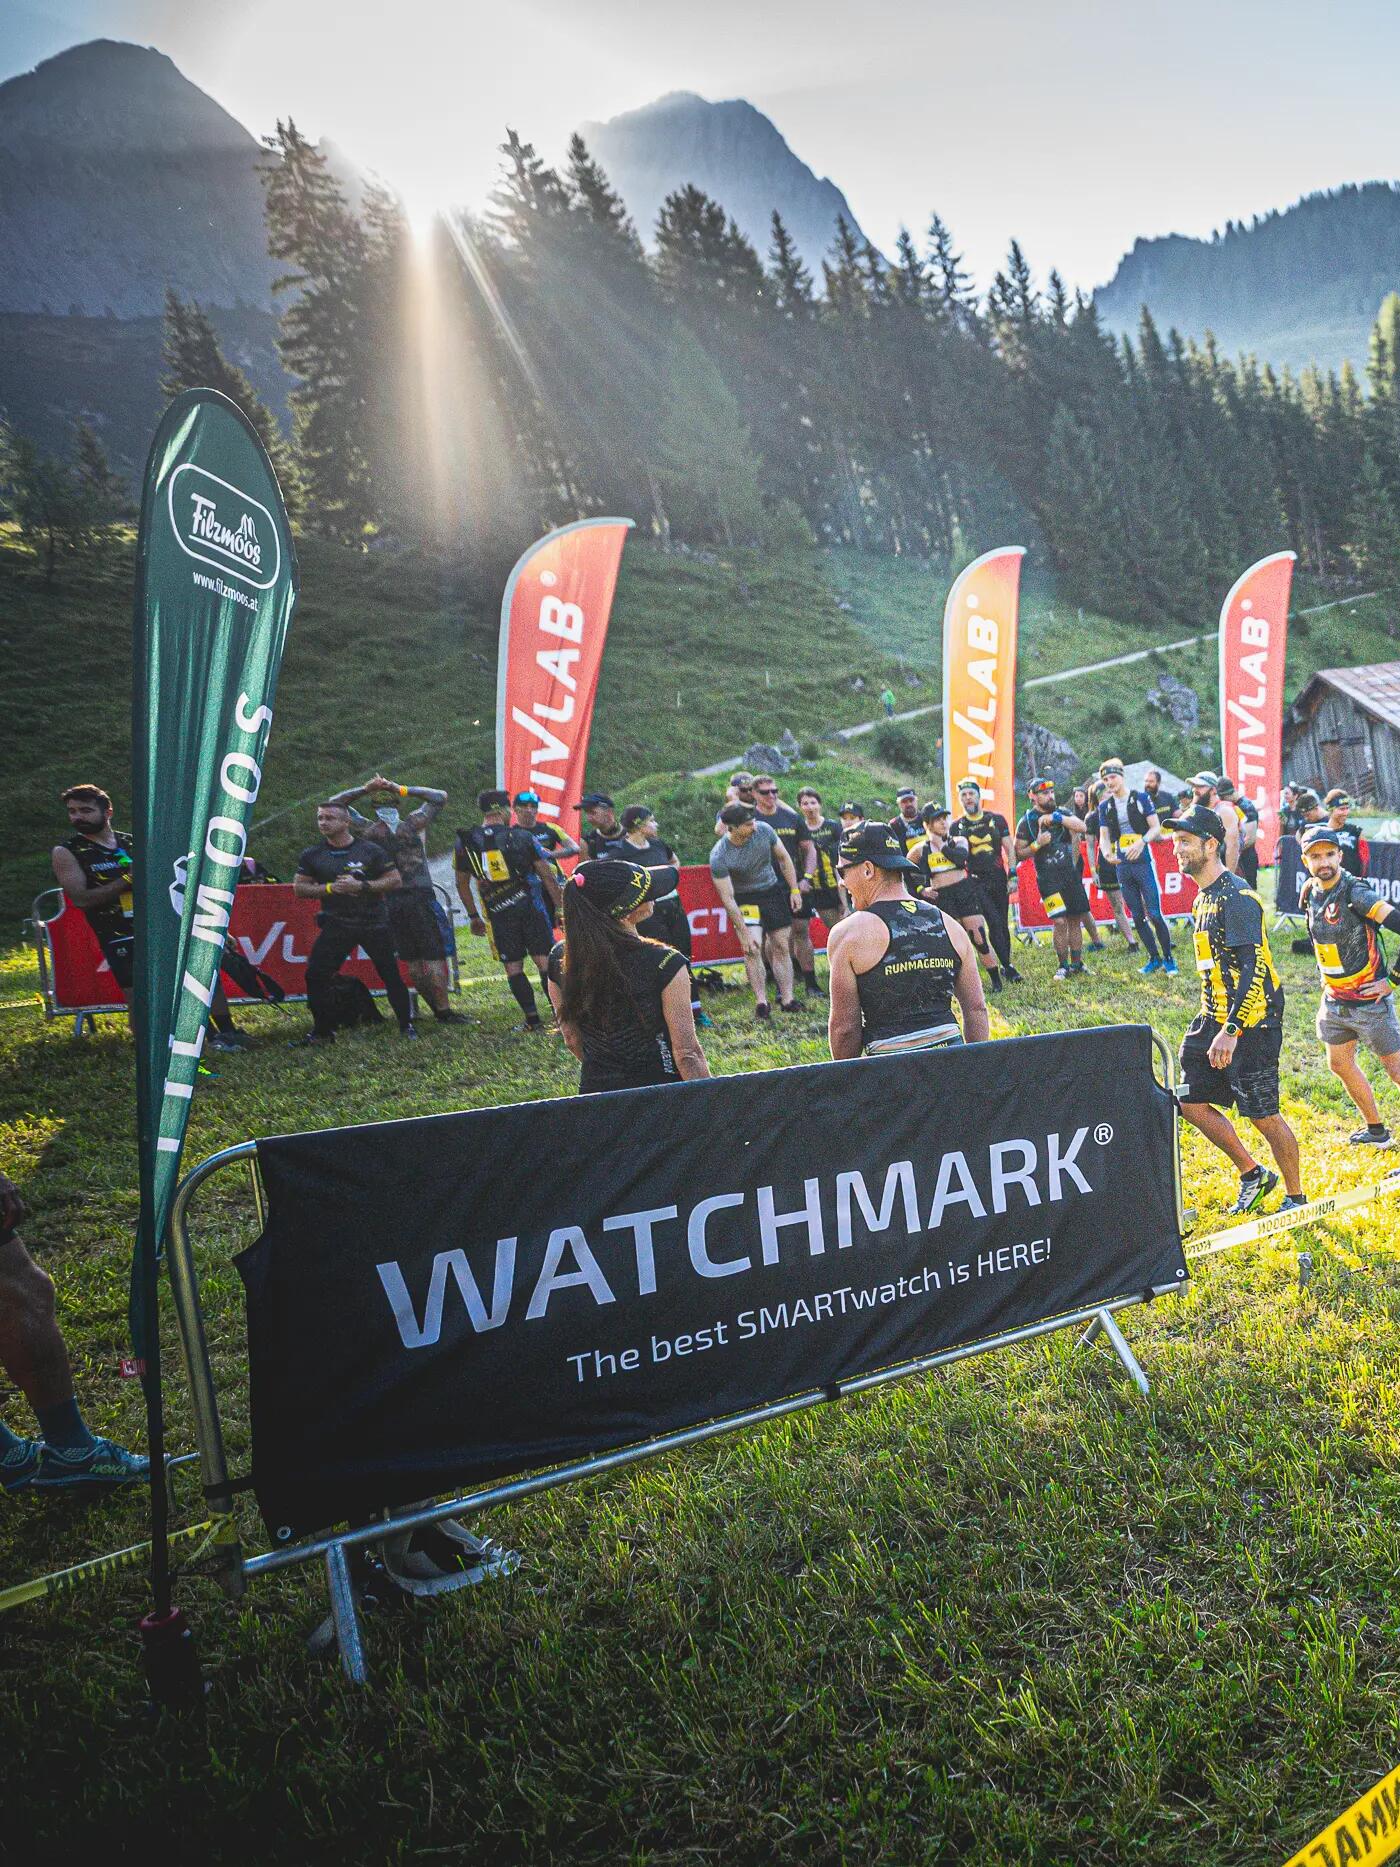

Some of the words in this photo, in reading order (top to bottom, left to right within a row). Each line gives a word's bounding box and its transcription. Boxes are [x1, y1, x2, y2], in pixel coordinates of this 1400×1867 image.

[190, 492, 261, 566] Filzmoos
[192, 571, 259, 612] www.filzmoos.at
[512, 594, 585, 819] TIVLAB
[884, 957, 954, 976] RUNMAGEDDON
[567, 1348, 640, 1382] The
[652, 1321, 729, 1362] best
[737, 1266, 942, 1340] SMARTwatch
[947, 1258, 971, 1286] is
[977, 1237, 1052, 1277] HERE!
